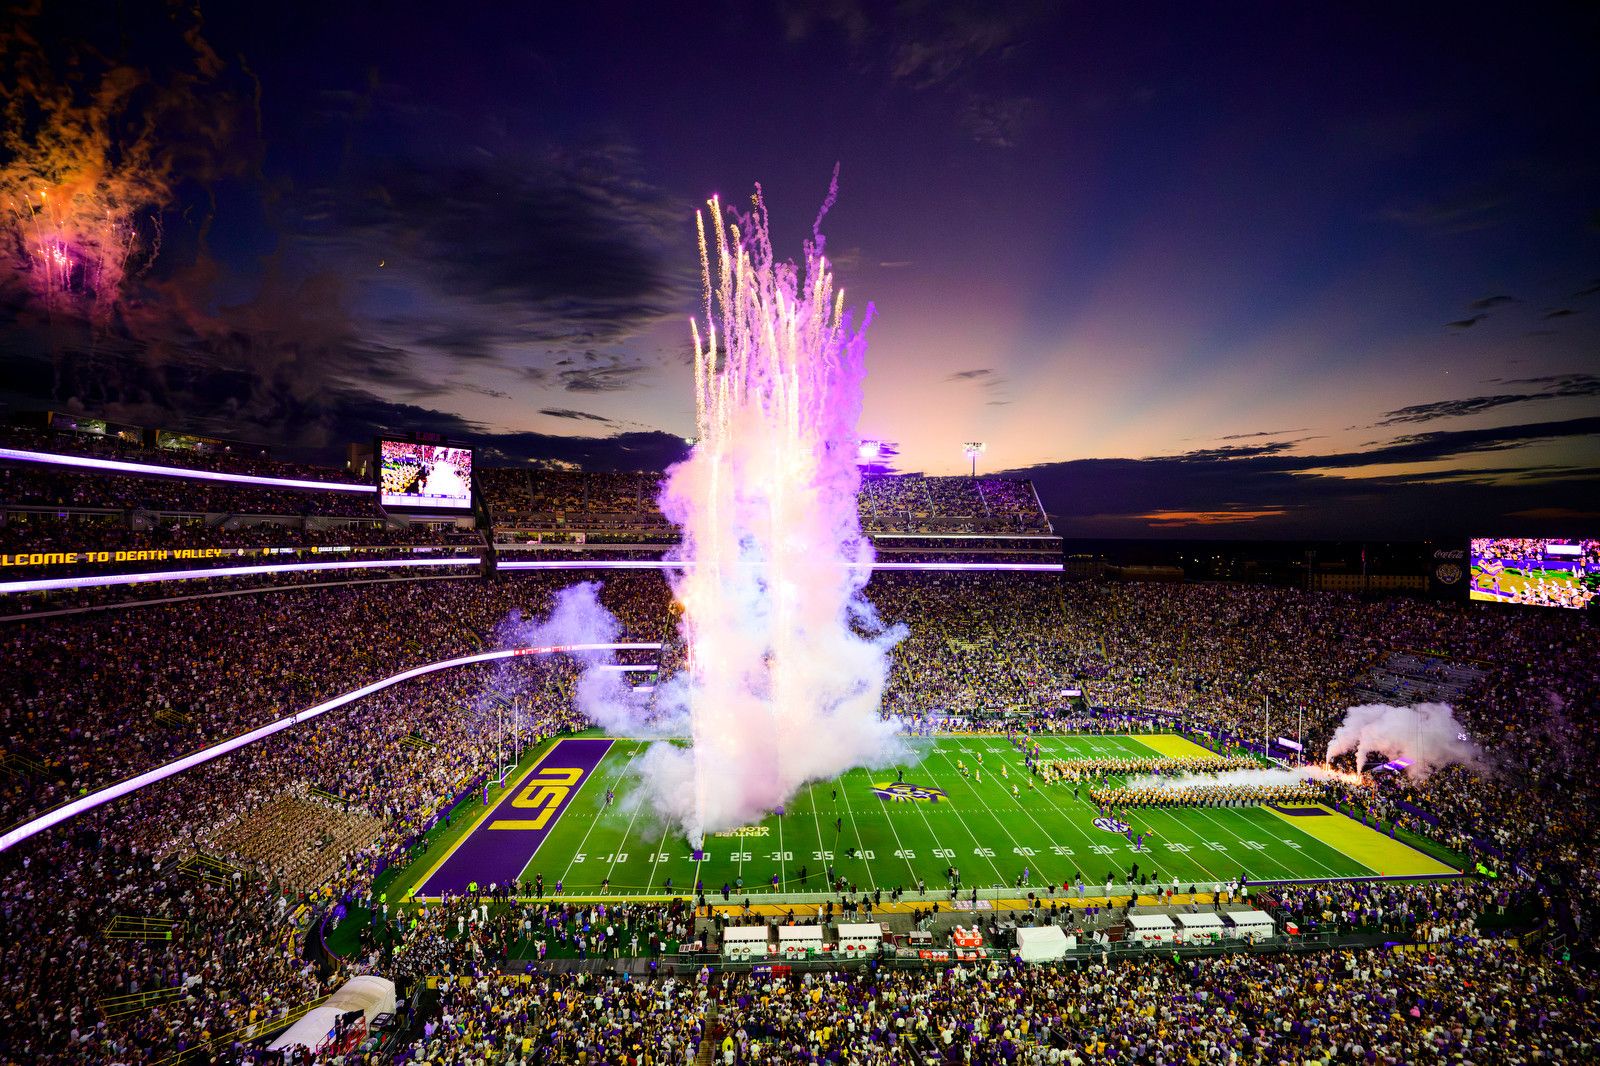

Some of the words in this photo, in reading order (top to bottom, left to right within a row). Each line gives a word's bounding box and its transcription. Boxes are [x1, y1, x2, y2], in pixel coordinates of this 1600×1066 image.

[0, 553, 77, 566] LCOME
[86, 552, 109, 563] TO
[115, 550, 167, 562] DEATH
[173, 548, 222, 559] VALLEY
[1457, 732, 1467, 741] 25
[487, 768, 584, 830] LSU
[1163, 843, 1190, 852] 20
[1202, 841, 1228, 851] 15
[1239, 840, 1265, 850] 10
[1282, 839, 1302, 849] 5
[893, 849, 916, 859] 45
[932, 848, 956, 858] 50
[973, 847, 996, 857] 45
[1012, 846, 1036, 856] 40
[1049, 846, 1075, 856] 35
[1088, 845, 1114, 854] 30
[574, 853, 587, 863] 5
[606, 853, 628, 863] 10
[648, 853, 670, 863] 15
[730, 851, 752, 862] 25
[771, 851, 793, 861] 30
[812, 851, 834, 860] 35
[853, 850, 875, 860] 40
